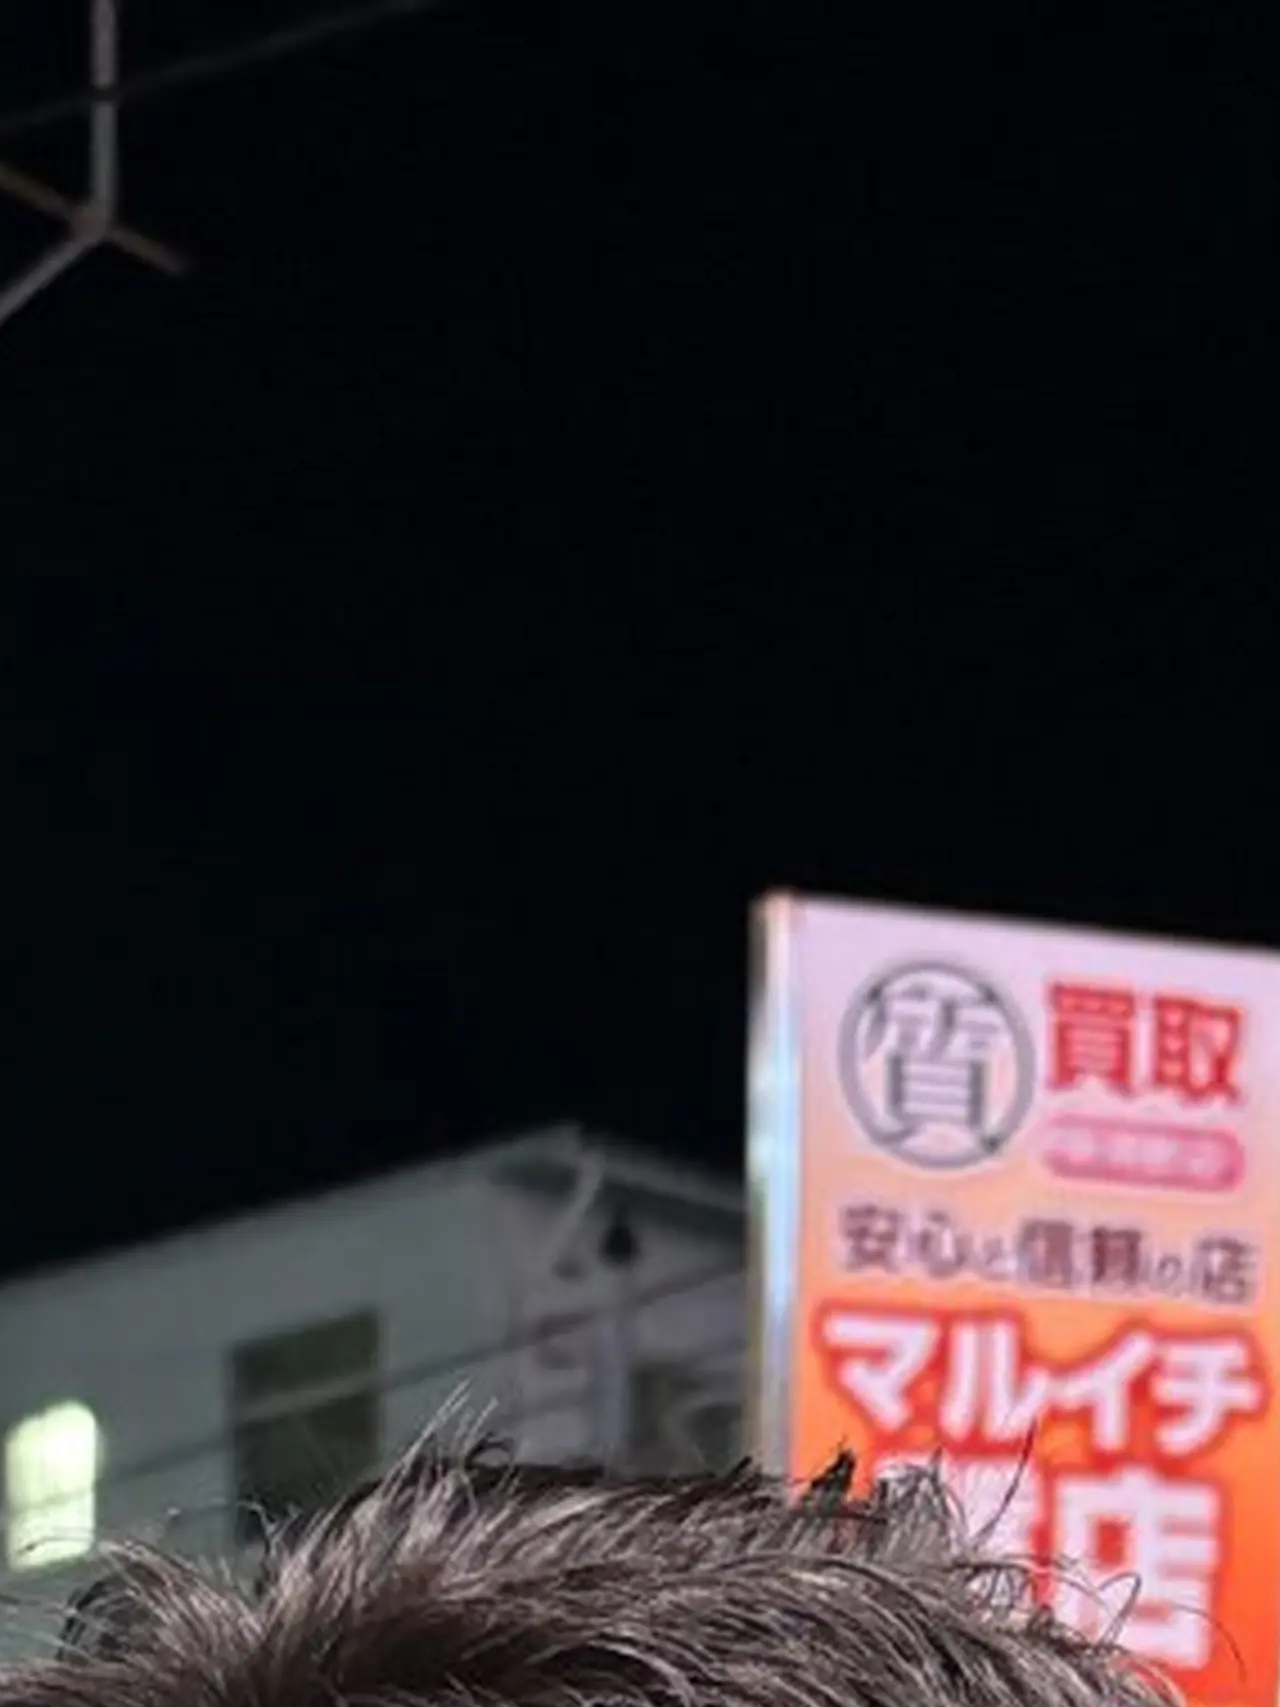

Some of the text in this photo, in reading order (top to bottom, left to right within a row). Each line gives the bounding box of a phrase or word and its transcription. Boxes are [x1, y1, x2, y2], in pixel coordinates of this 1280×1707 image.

[1043, 979, 1245, 1108] 買取
[821, 1310, 1263, 1454] マルイチ
